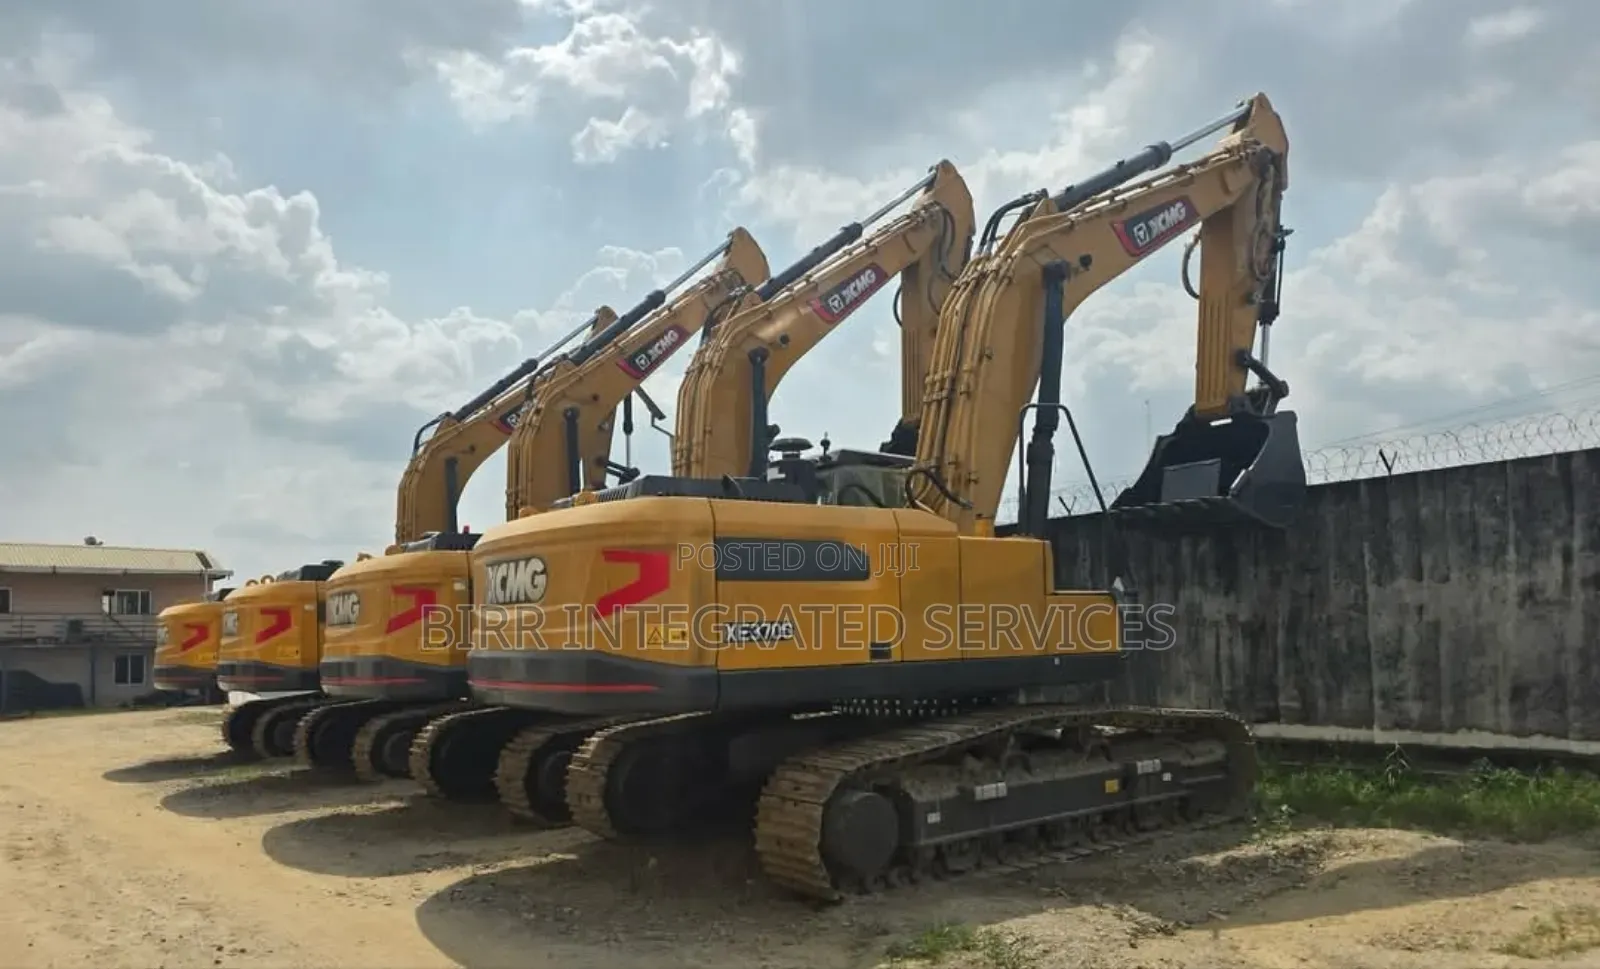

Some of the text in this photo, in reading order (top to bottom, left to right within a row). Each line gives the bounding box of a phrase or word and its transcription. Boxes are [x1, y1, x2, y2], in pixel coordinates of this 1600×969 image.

[1148, 202, 1186, 238] XCMG
[841, 269, 876, 304] XCMG
[487, 558, 547, 604] XCMG
